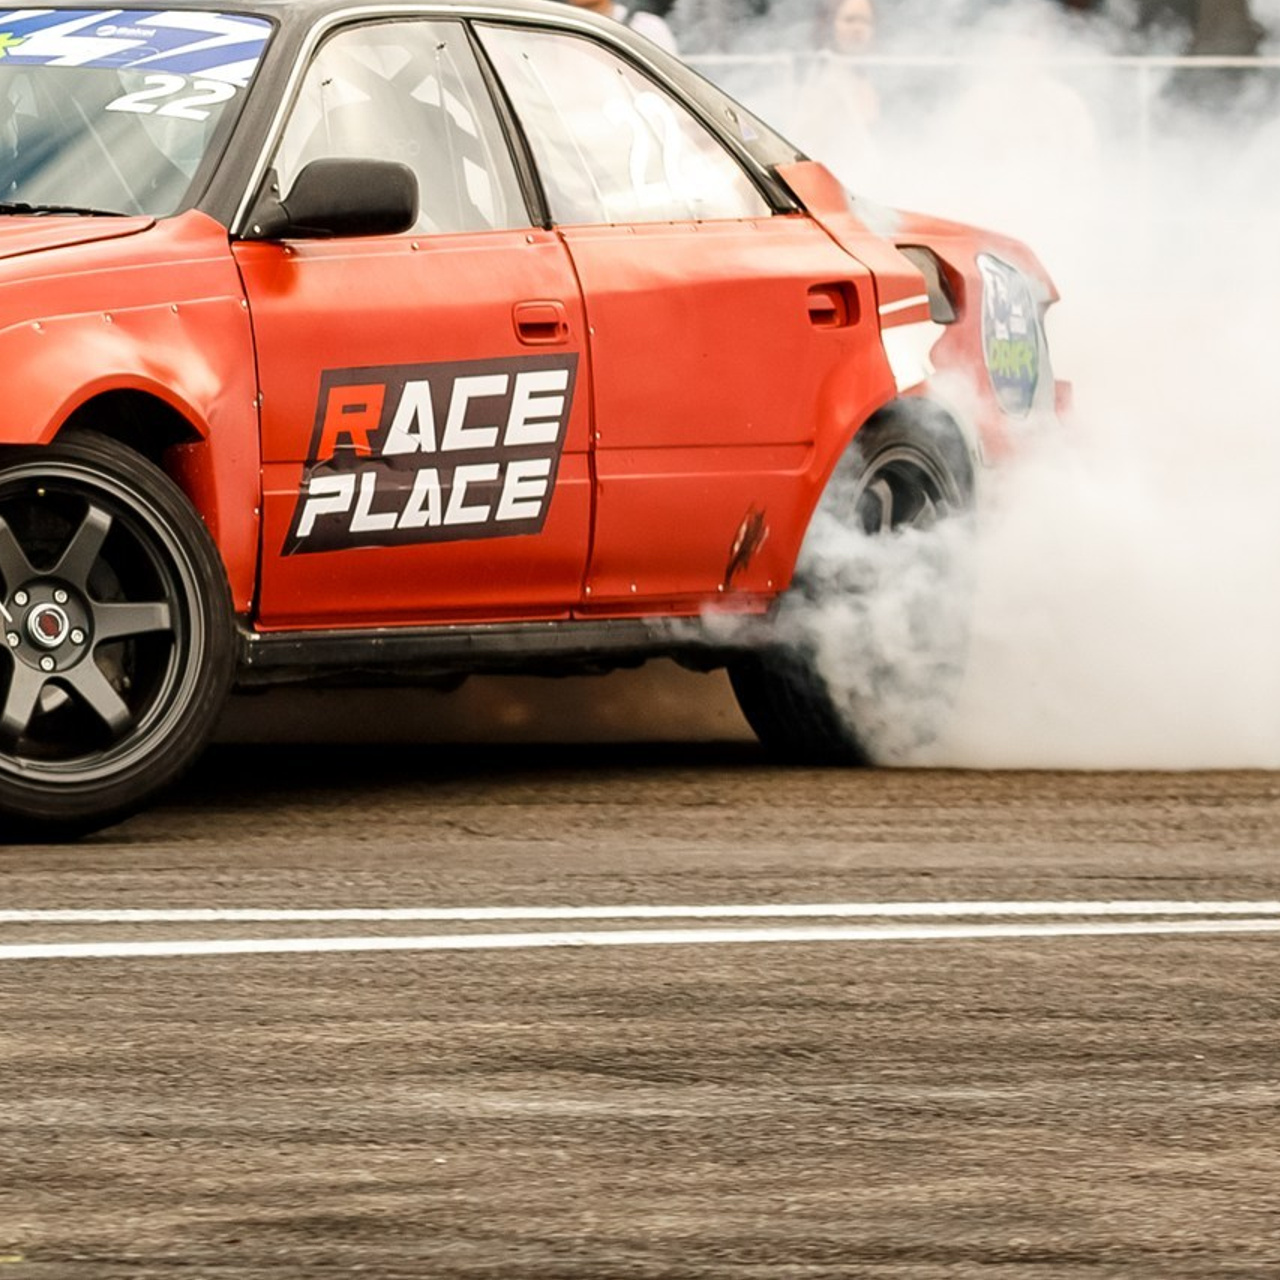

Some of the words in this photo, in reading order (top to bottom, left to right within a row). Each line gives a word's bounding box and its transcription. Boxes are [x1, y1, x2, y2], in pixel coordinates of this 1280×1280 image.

[104, 73, 237, 121] 22
[317, 370, 569, 461] RACE
[296, 458, 552, 538] PLACE
